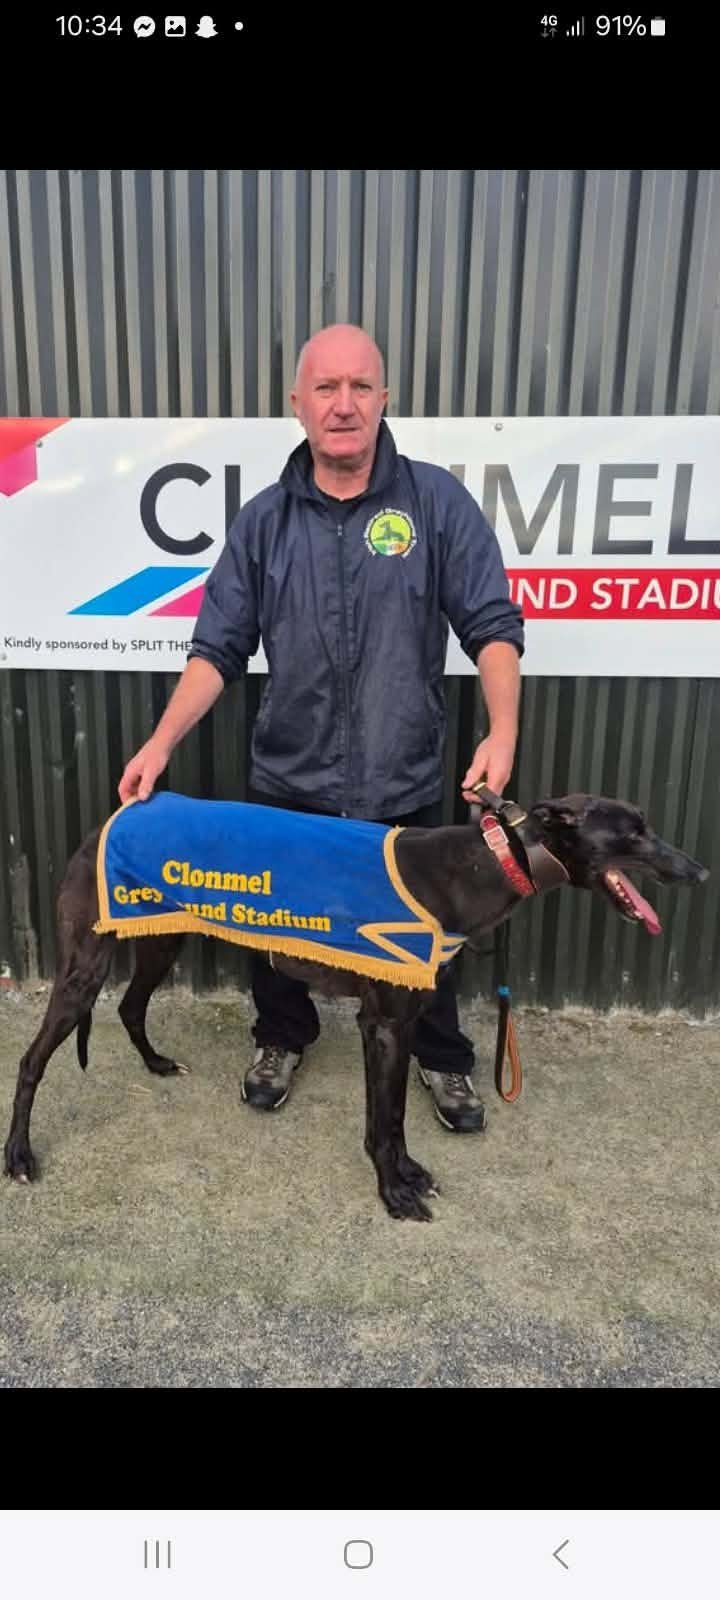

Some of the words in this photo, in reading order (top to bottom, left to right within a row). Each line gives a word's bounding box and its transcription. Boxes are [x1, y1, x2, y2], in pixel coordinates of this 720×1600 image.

[3, 636, 42, 652] Kindly
[45, 638, 108, 652] sponsored
[111, 638, 128, 654] by
[130, 639, 164, 651] SPLIT
[162, 859, 272, 896] Clonmel
[231, 902, 332, 933] Stadium
